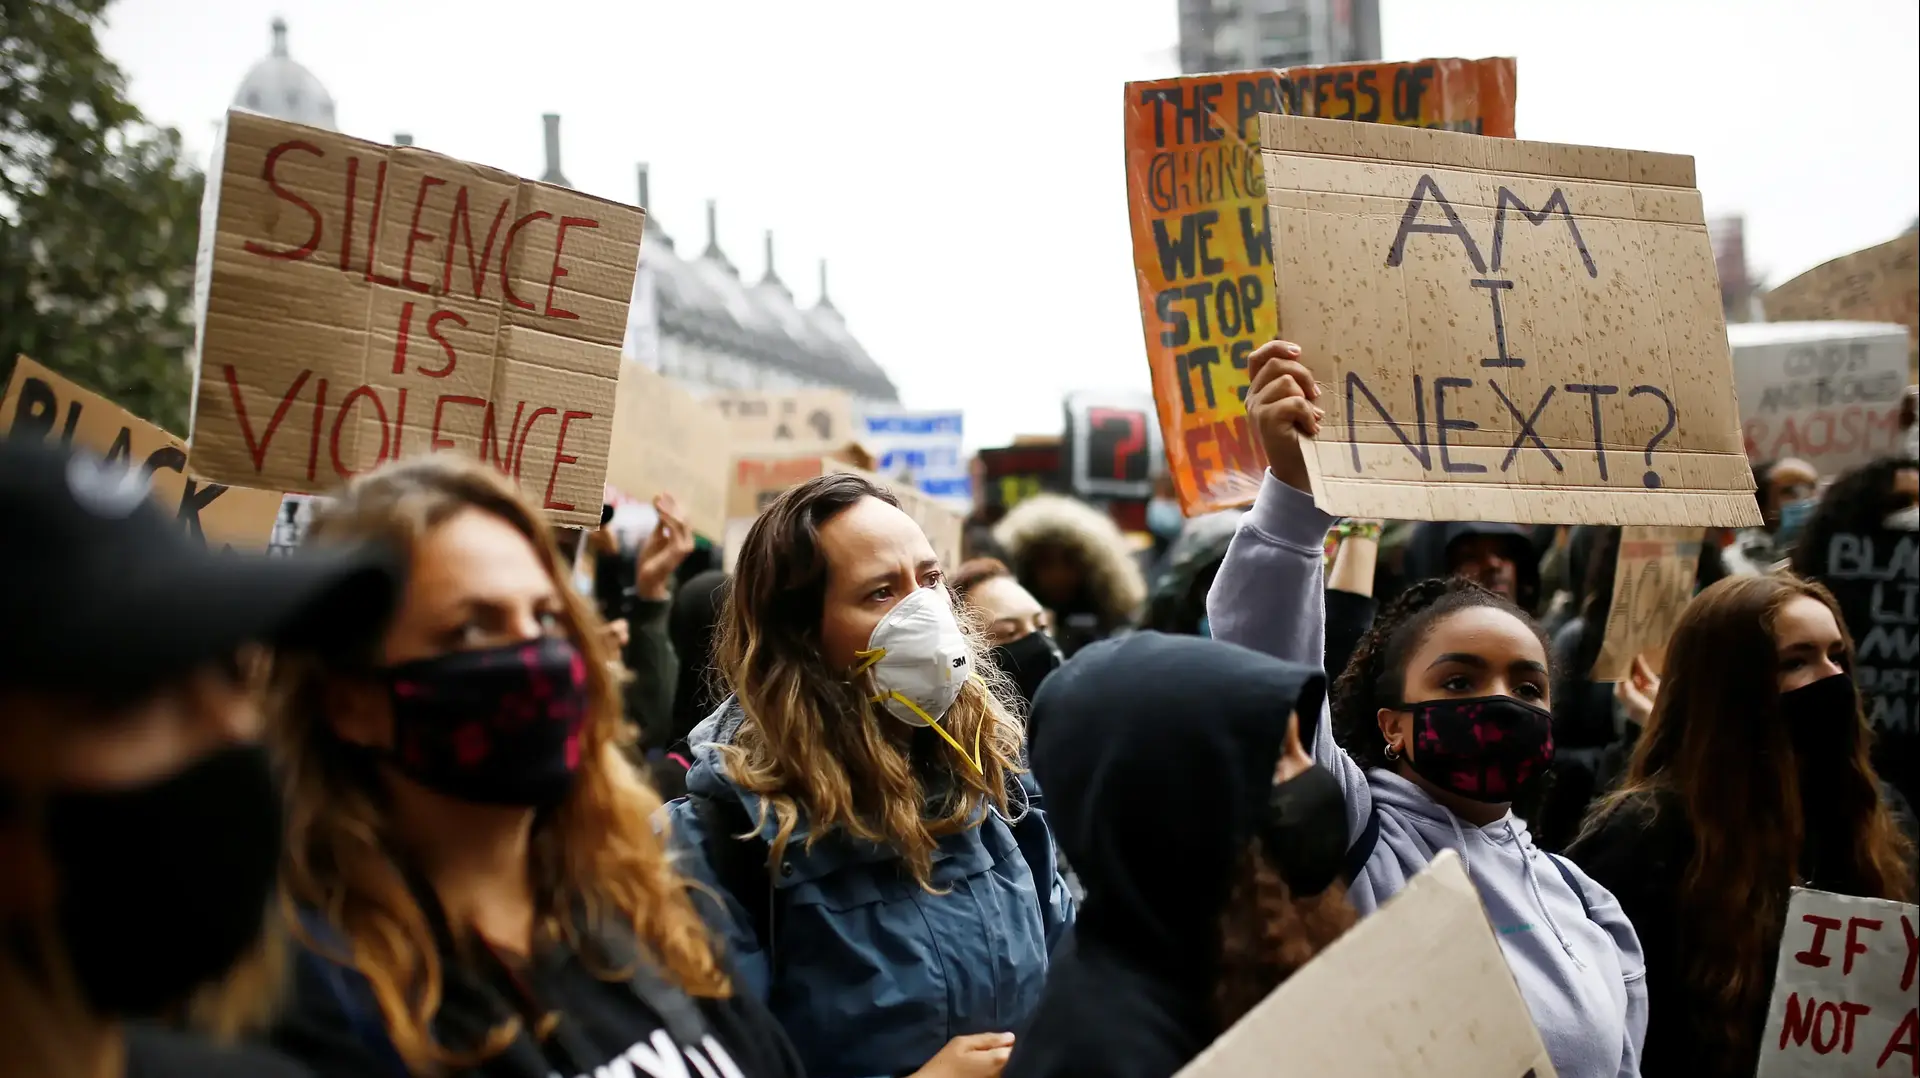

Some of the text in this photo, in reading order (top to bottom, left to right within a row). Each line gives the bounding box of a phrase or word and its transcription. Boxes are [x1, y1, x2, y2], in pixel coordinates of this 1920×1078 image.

[1141, 82, 1226, 149] THE
[1392, 65, 1434, 122] OF
[1147, 141, 1267, 213] CHANG
[244, 139, 600, 320] SILENCE
[1151, 209, 1225, 283] WE
[1386, 173, 1598, 279] AM
[392, 301, 469, 378] IS
[1155, 274, 1264, 348] STOP
[1470, 278, 1526, 368] I
[223, 363, 594, 511] VIOLENCE
[1344, 370, 1677, 490] NEXT?
[952, 655, 967, 669] 3M
[1794, 914, 1884, 976] IF
[1778, 991, 1873, 1056] NOT
